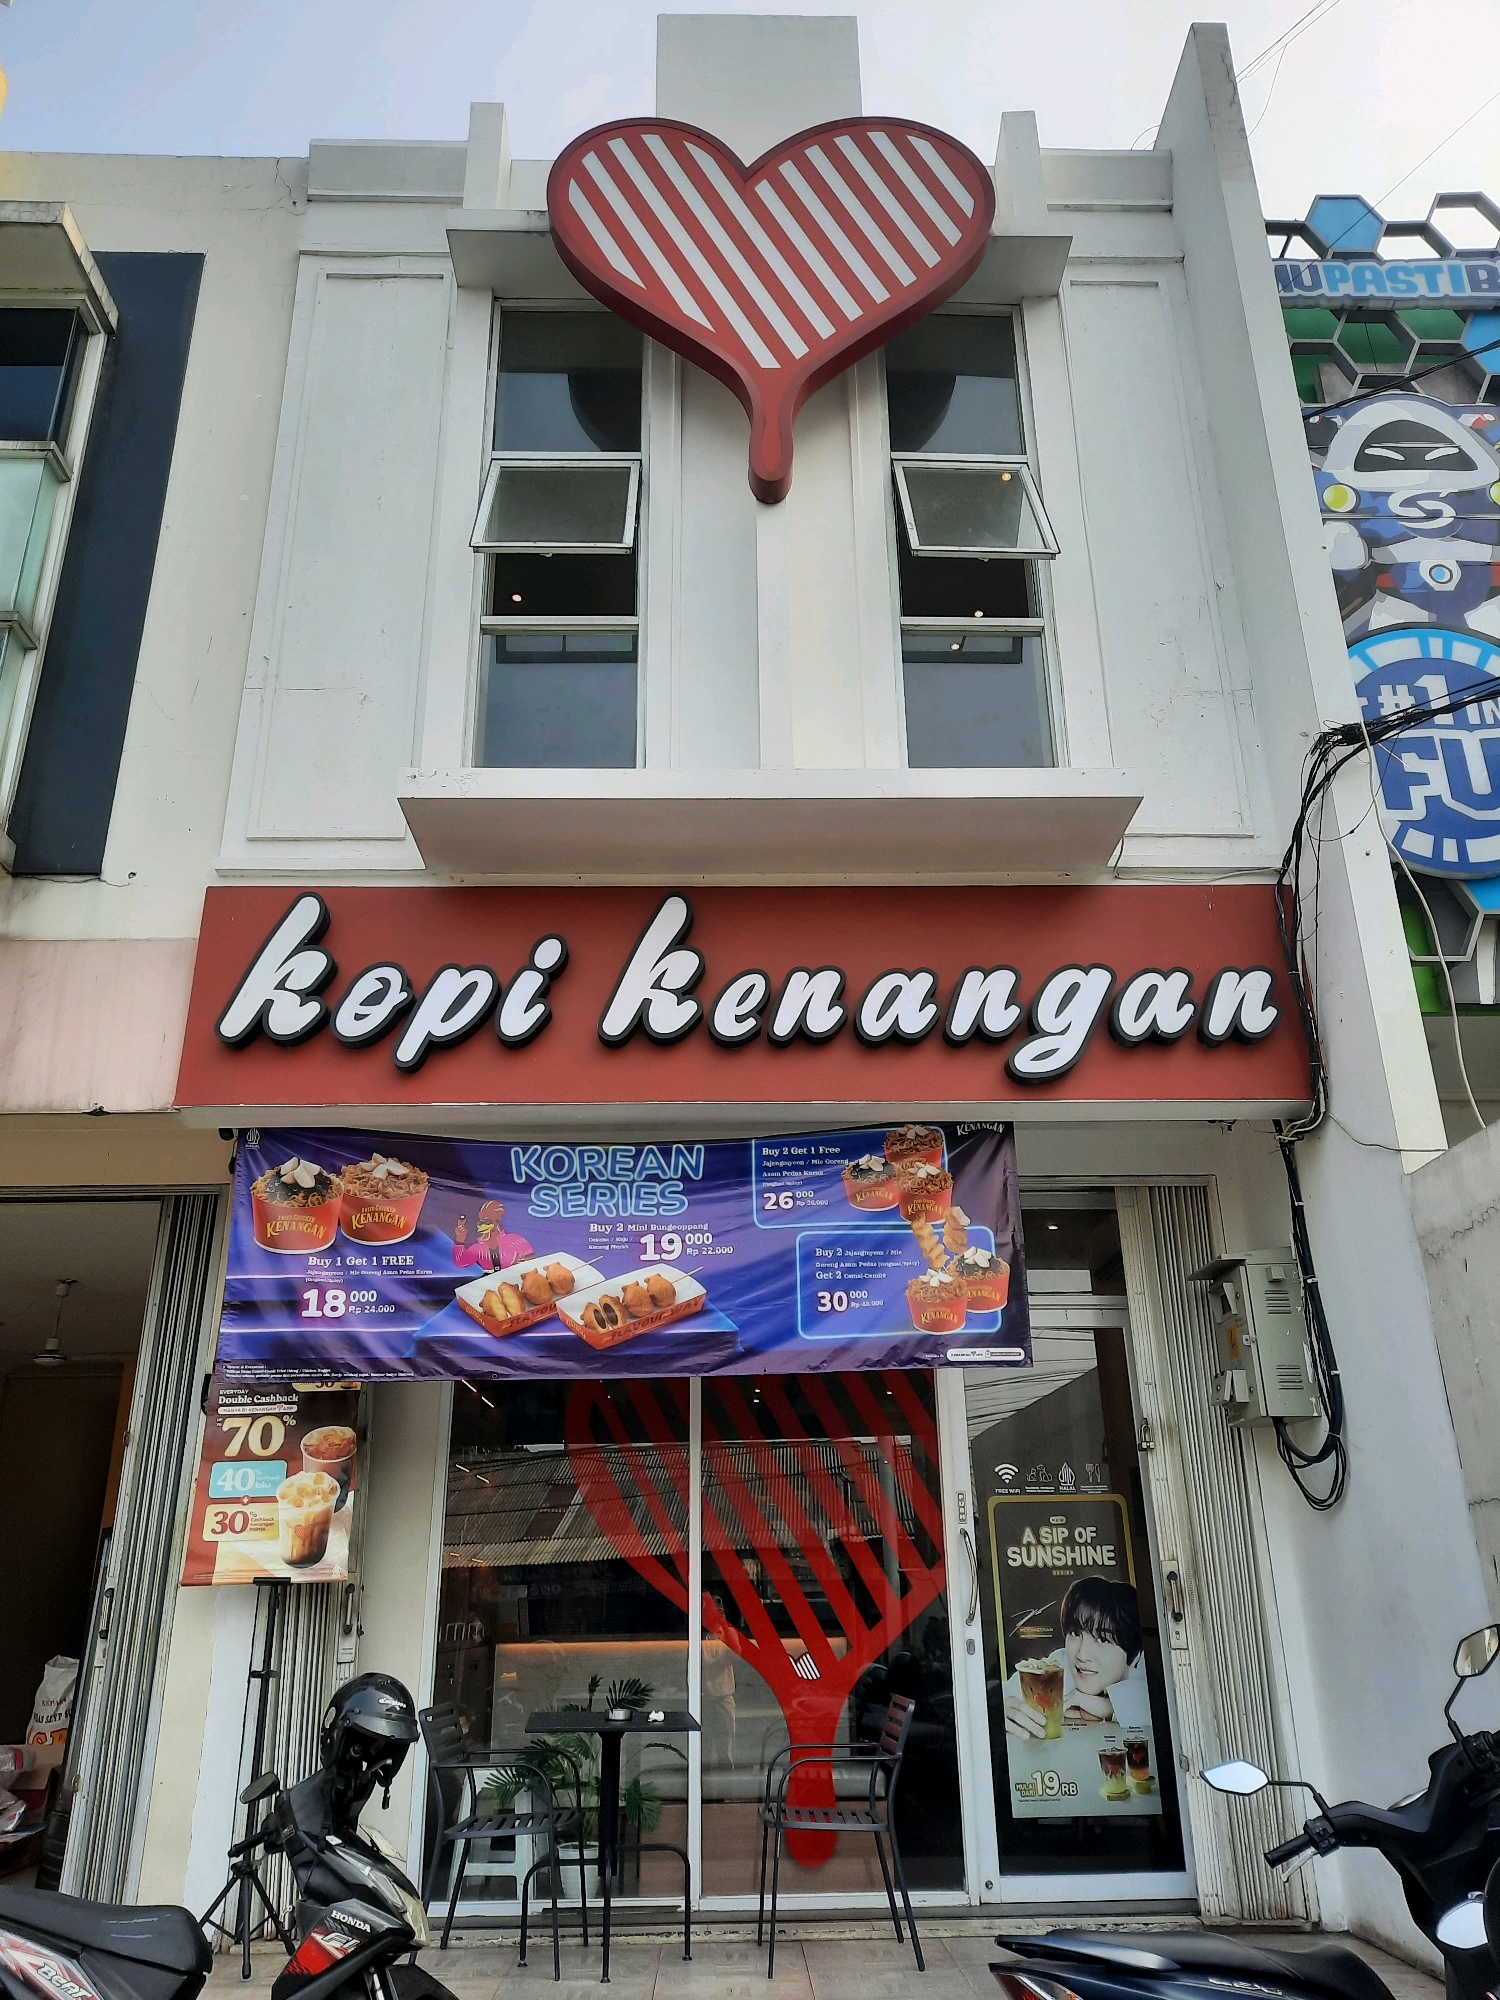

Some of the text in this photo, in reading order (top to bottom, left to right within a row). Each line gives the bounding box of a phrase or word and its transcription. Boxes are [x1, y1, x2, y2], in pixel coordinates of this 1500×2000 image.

[217, 893, 1279, 1083] kopi kenangan
[956, 1122, 1005, 1137] KENANGAN
[762, 1146, 841, 1157] Buy 2 Get 1 Free
[510, 1144, 705, 1184] KOREAN
[527, 1181, 689, 1218] SERIES
[763, 1190, 815, 1210] 26 000
[855, 1190, 893, 1203] KENANGAN
[907, 1203, 943, 1216] KENANGAN
[351, 1210, 408, 1230] KENANGAN
[266, 1219, 327, 1240] KENANGAN
[589, 1222, 709, 1234] Buy 2 Mini Bungeoppang
[640, 1232, 713, 1261] 19 000
[686, 1247, 699, 1257] Rp
[815, 1248, 834, 1258] Buy
[836, 1247, 843, 1256] 2
[308, 1256, 414, 1268] Buy 1 Get 1 FREE
[815, 1271, 833, 1280] Get
[836, 1270, 842, 1279] 2
[817, 1290, 868, 1312] 30 000
[966, 1288, 1000, 1301] ENANGAN
[301, 1288, 378, 1318] 18 000
[348, 1305, 361, 1315] Rp
[920, 1310, 959, 1324] KENANGAN
[218, 1393, 299, 1404] Double Cashback
[255, 1481, 272, 1489] blu
[1022, 1526, 1097, 1545] A SIP OF
[1006, 1545, 1117, 1568] SUNSHINE
[1015, 1783, 1035, 1791] MULAI
[1031, 1770, 1078, 1797] 19 RB
[331, 1910, 371, 1933] HONDA
